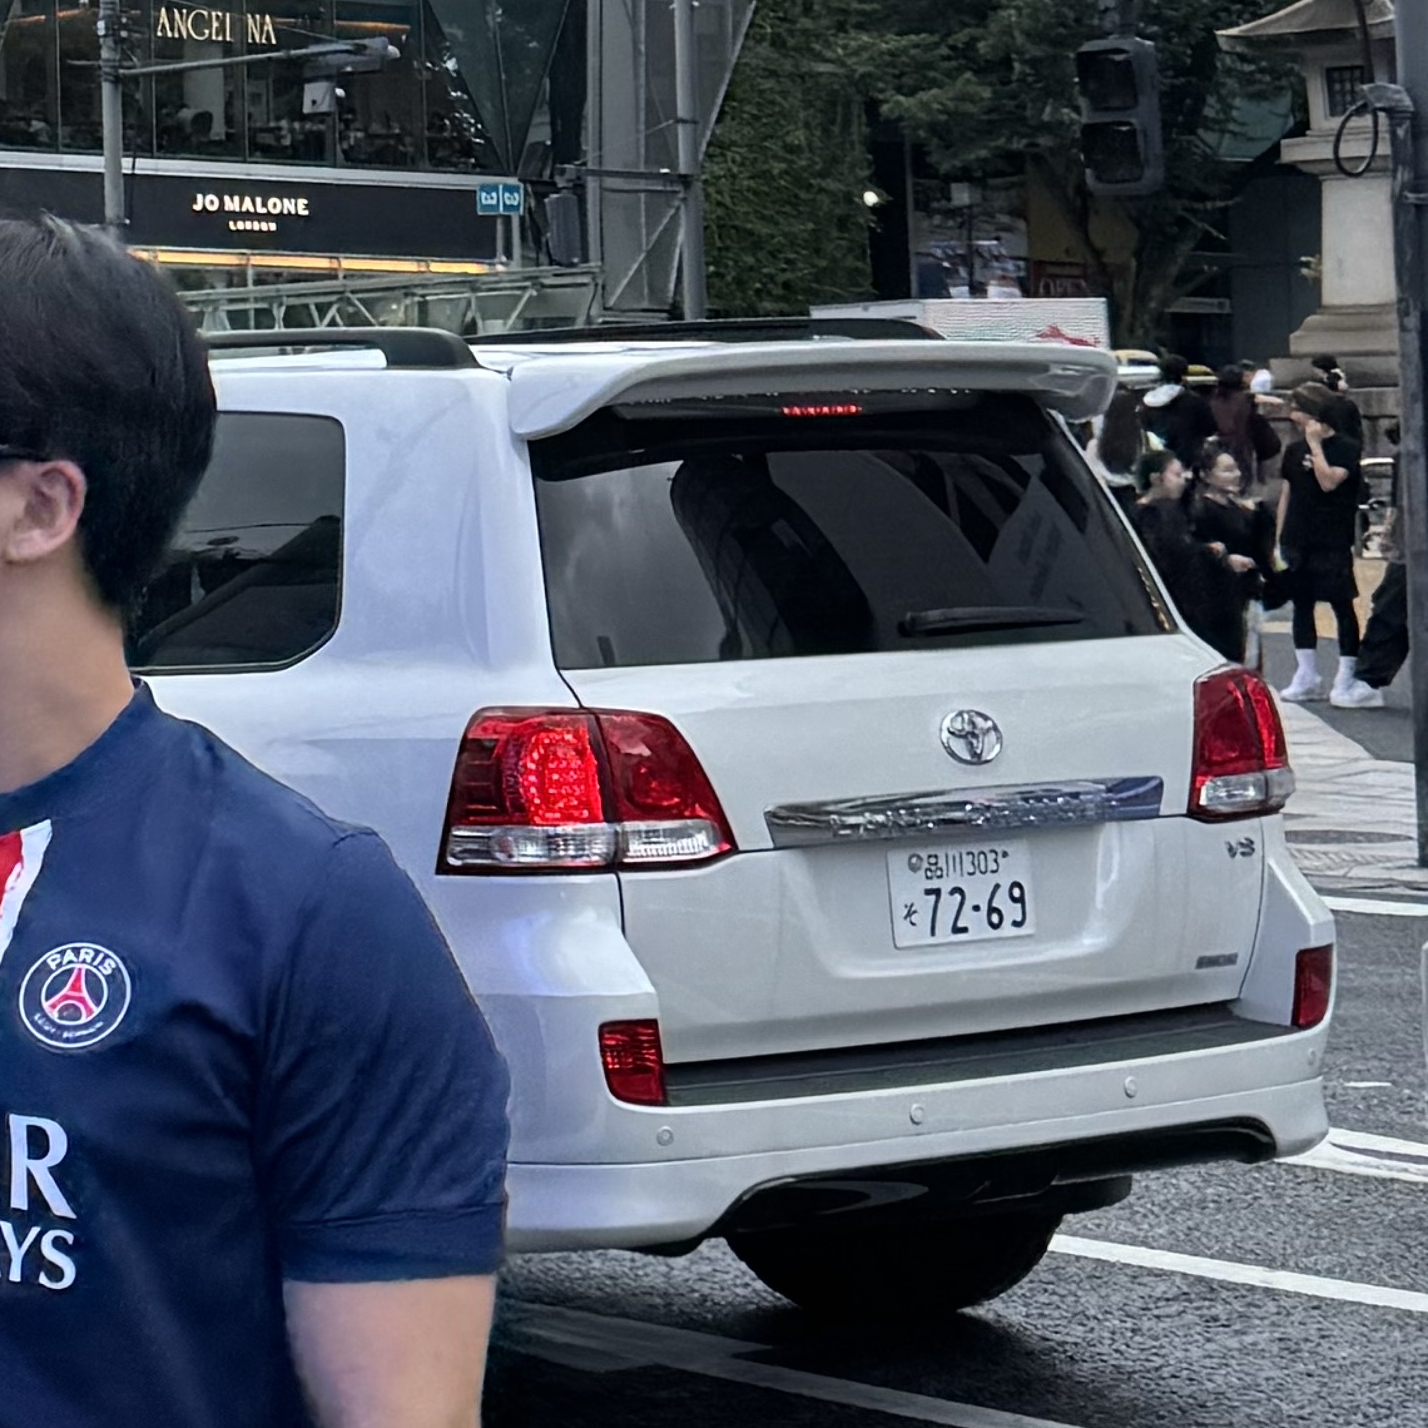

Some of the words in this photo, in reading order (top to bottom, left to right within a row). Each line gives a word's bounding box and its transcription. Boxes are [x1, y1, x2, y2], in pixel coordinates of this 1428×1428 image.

[193, 193, 220, 213] JO
[224, 194, 310, 217] MALONE
[923, 880, 1027, 938] 72-69
[46, 947, 117, 976] PARIS
